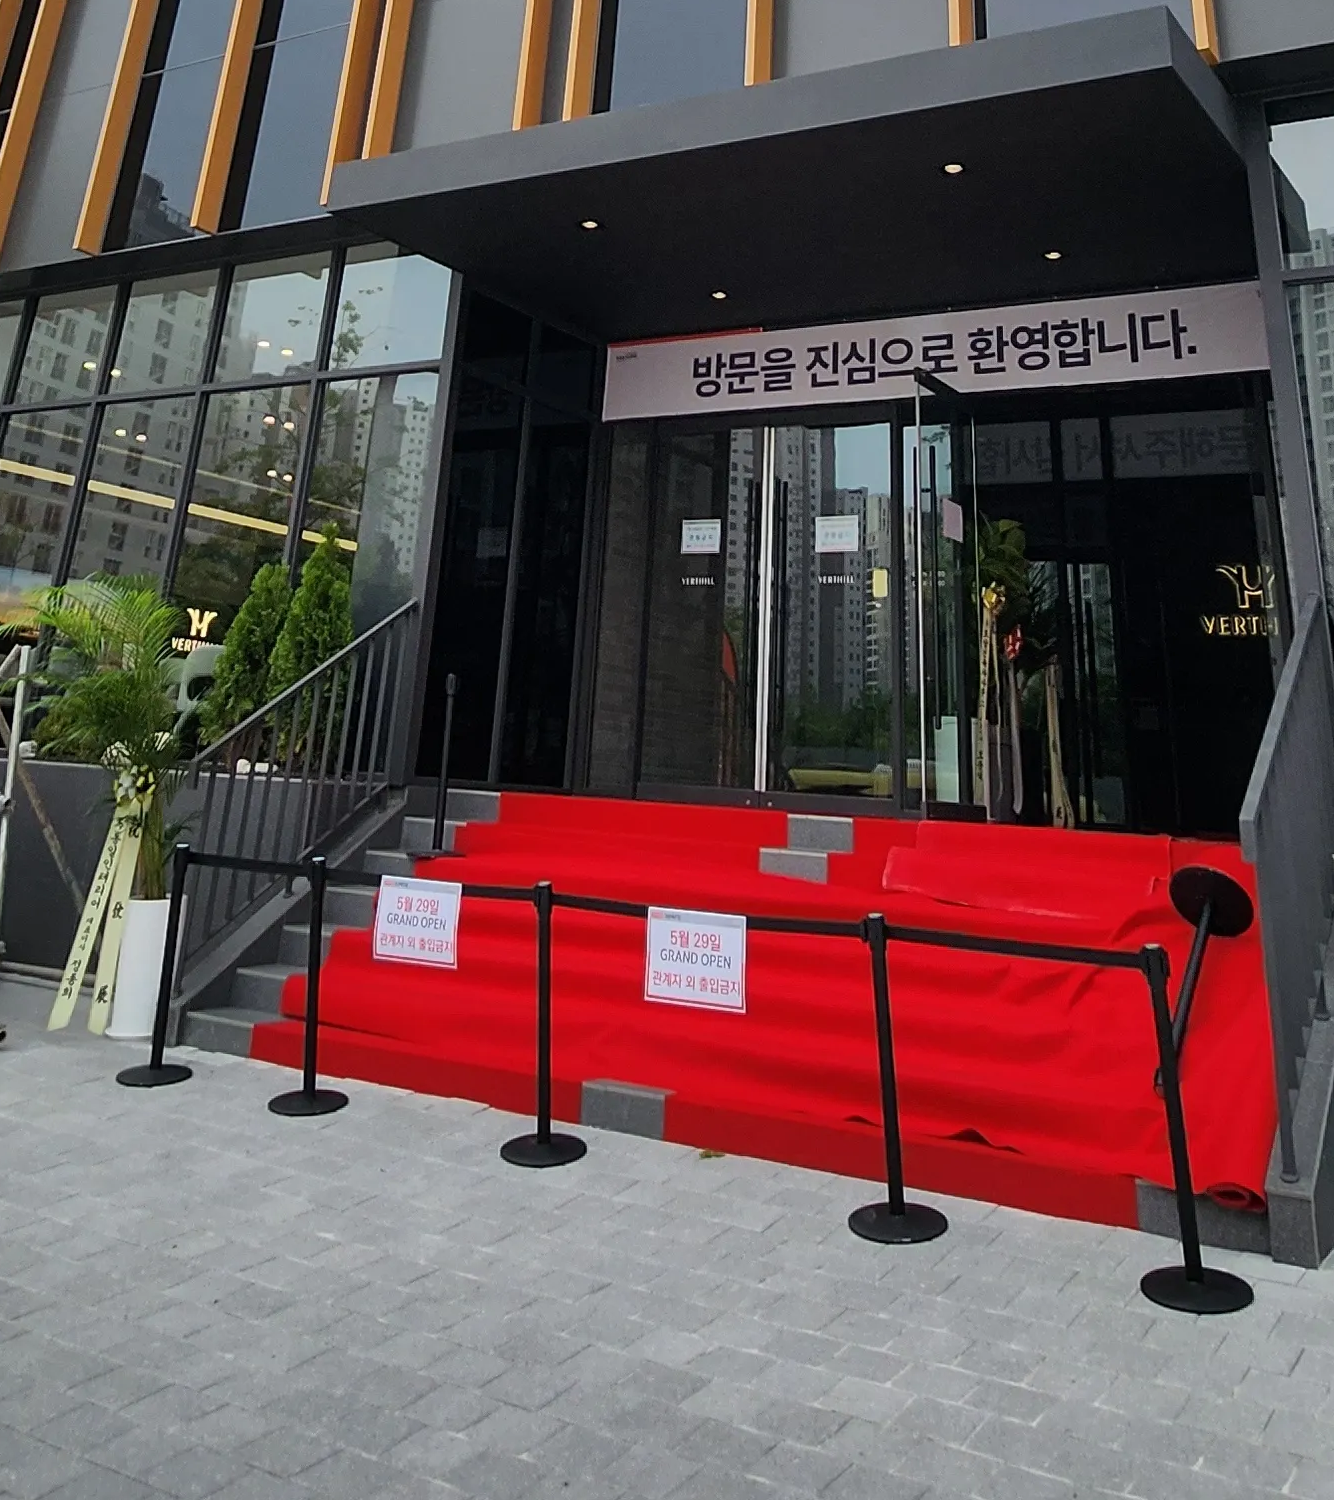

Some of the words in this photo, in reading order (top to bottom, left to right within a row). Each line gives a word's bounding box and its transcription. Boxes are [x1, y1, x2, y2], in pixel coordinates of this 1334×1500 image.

[692, 347, 797, 397] 방문을
[805, 332, 958, 387] 진심으로
[967, 308, 1197, 375] 환영합니다.
[818, 575, 855, 584] VERTHILL
[396, 896, 412, 913] 5월
[415, 897, 440, 916] 29일
[386, 913, 419, 930] GRAND
[420, 915, 447, 932] OPEN
[379, 933, 405, 949] 관계자
[407, 935, 417, 949] 외
[418, 937, 454, 954] 출입금지
[670, 930, 690, 948] 5월
[693, 933, 722, 952] 29일
[660, 948, 698, 966] GRAND
[701, 952, 732, 970] OPEN
[652, 970, 683, 988] 관계자
[685, 974, 696, 991] 외
[699, 976, 741, 996] 출입금지
